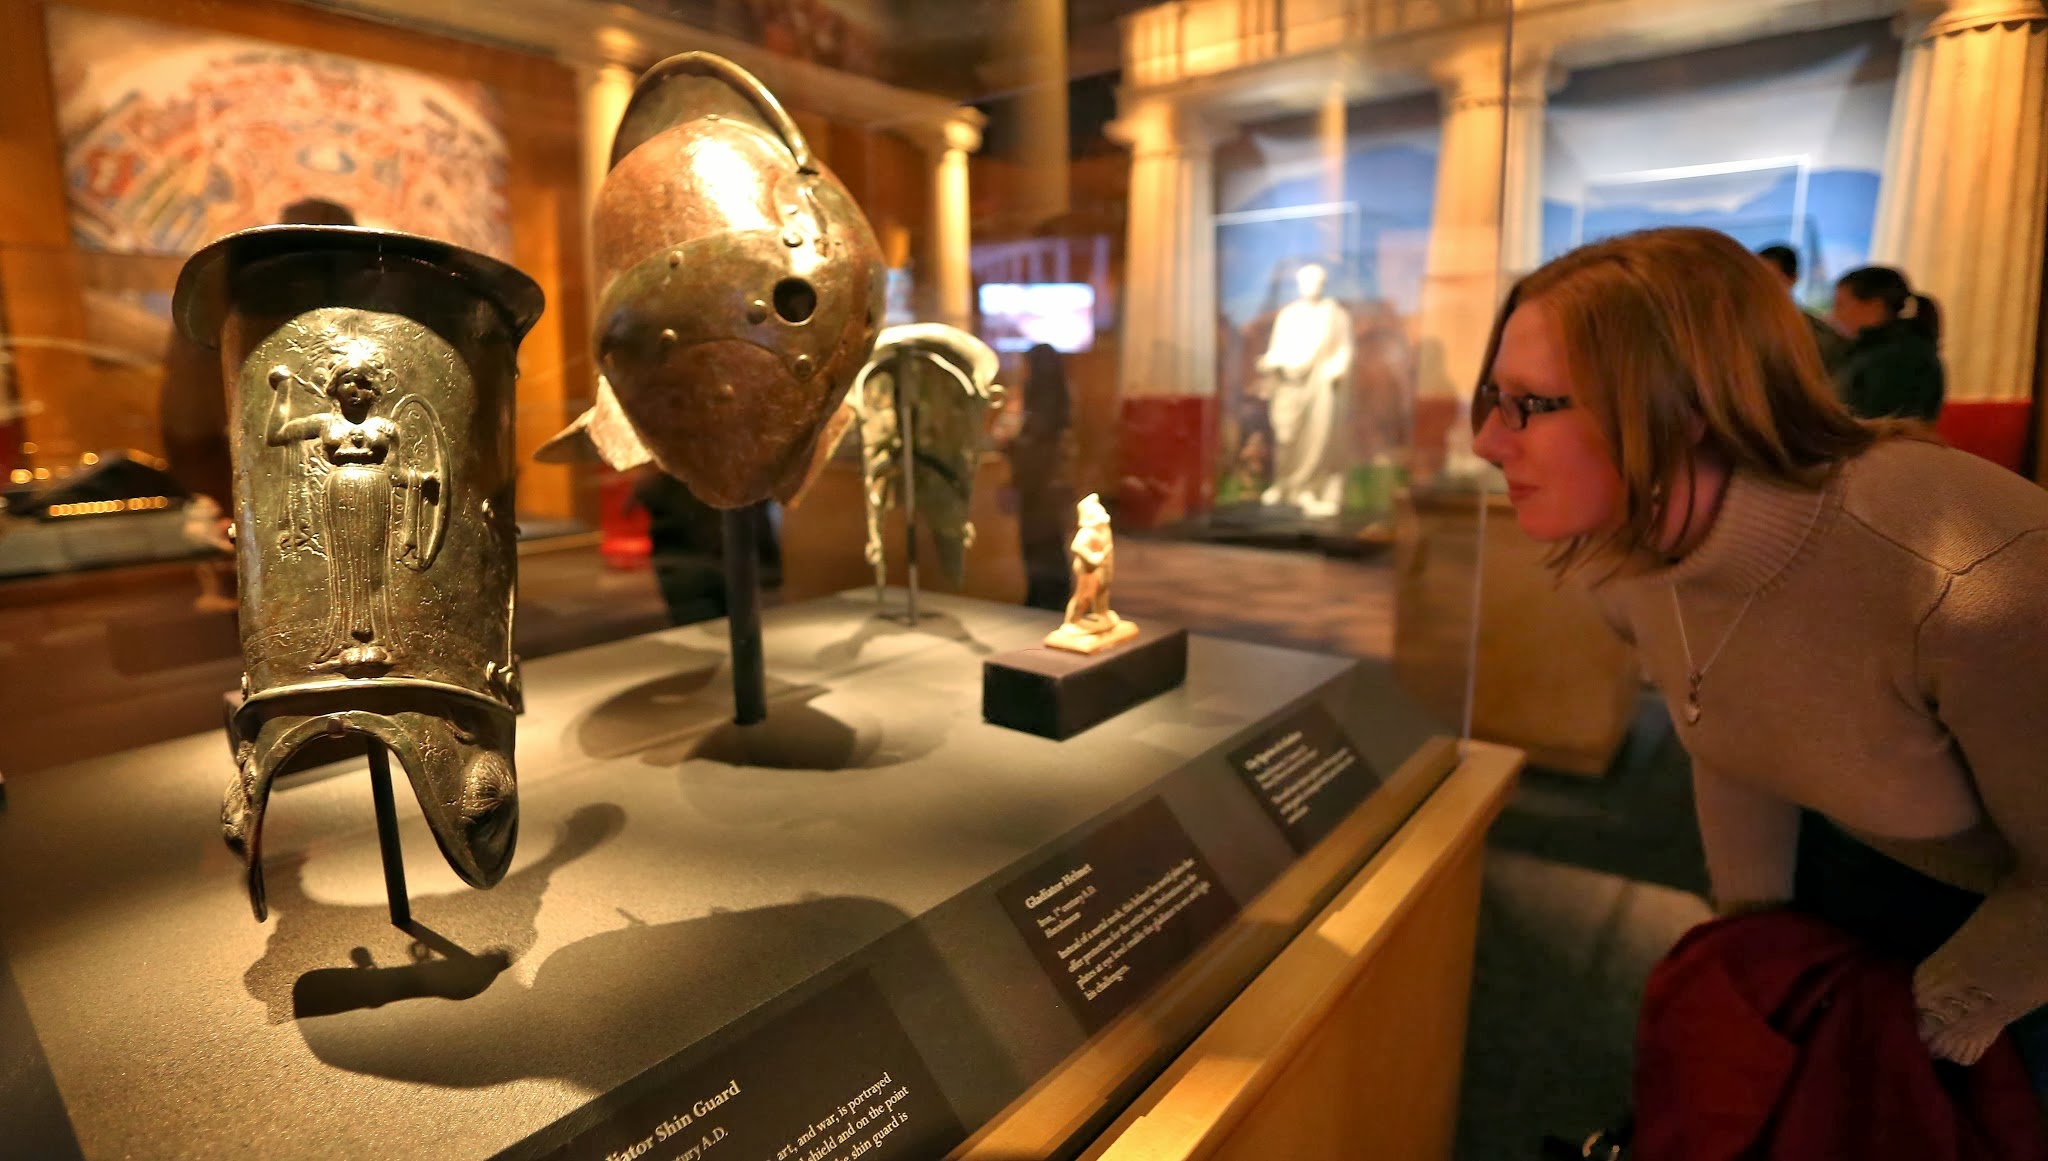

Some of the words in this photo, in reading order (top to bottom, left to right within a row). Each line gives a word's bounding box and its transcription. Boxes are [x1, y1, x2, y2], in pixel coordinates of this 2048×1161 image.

[655, 1114, 693, 1143] Shin
[693, 1079, 741, 1118] Guard
[702, 1126, 729, 1150] A.D.
[776, 1144, 799, 1161] art,
[797, 1124, 817, 1147] and
[816, 1113, 840, 1132] war,
[837, 1106, 848, 1118] is
[847, 1071, 892, 1115] portrayed
[837, 1122, 857, 1144] and
[855, 1116, 870, 1130] on
[868, 1105, 885, 1120] the
[884, 1085, 909, 1113] point
[851, 1141, 873, 1161] shin
[872, 1115, 900, 1148] guard
[897, 1111, 909, 1123] is
